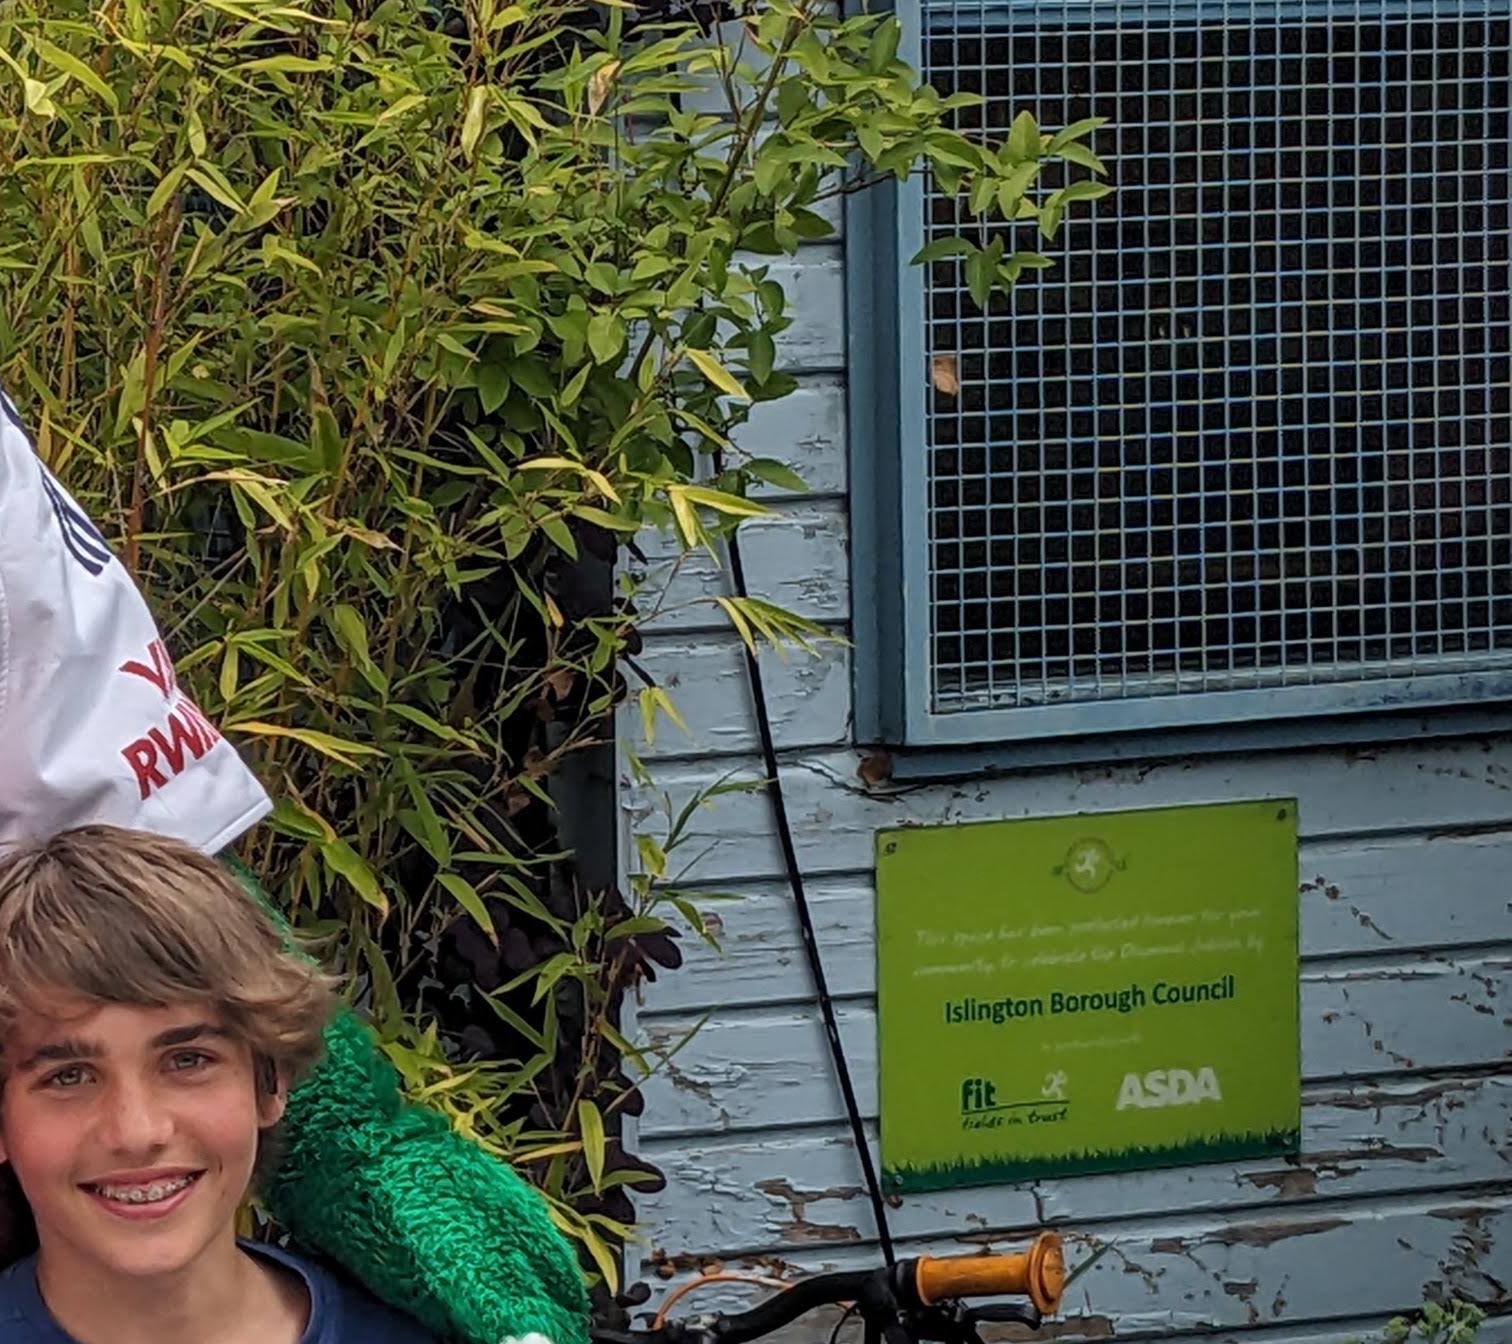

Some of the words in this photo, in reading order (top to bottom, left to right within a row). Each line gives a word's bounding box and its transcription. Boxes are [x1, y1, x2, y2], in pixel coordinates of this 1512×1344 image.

[945, 995, 1044, 1025] Islington
[1050, 985, 1146, 1014] Borough
[1152, 974, 1235, 1006] Council
[961, 1078, 996, 1110] fit
[1115, 1066, 1223, 1111] ASDA
[1028, 1106, 1068, 1125] trust
